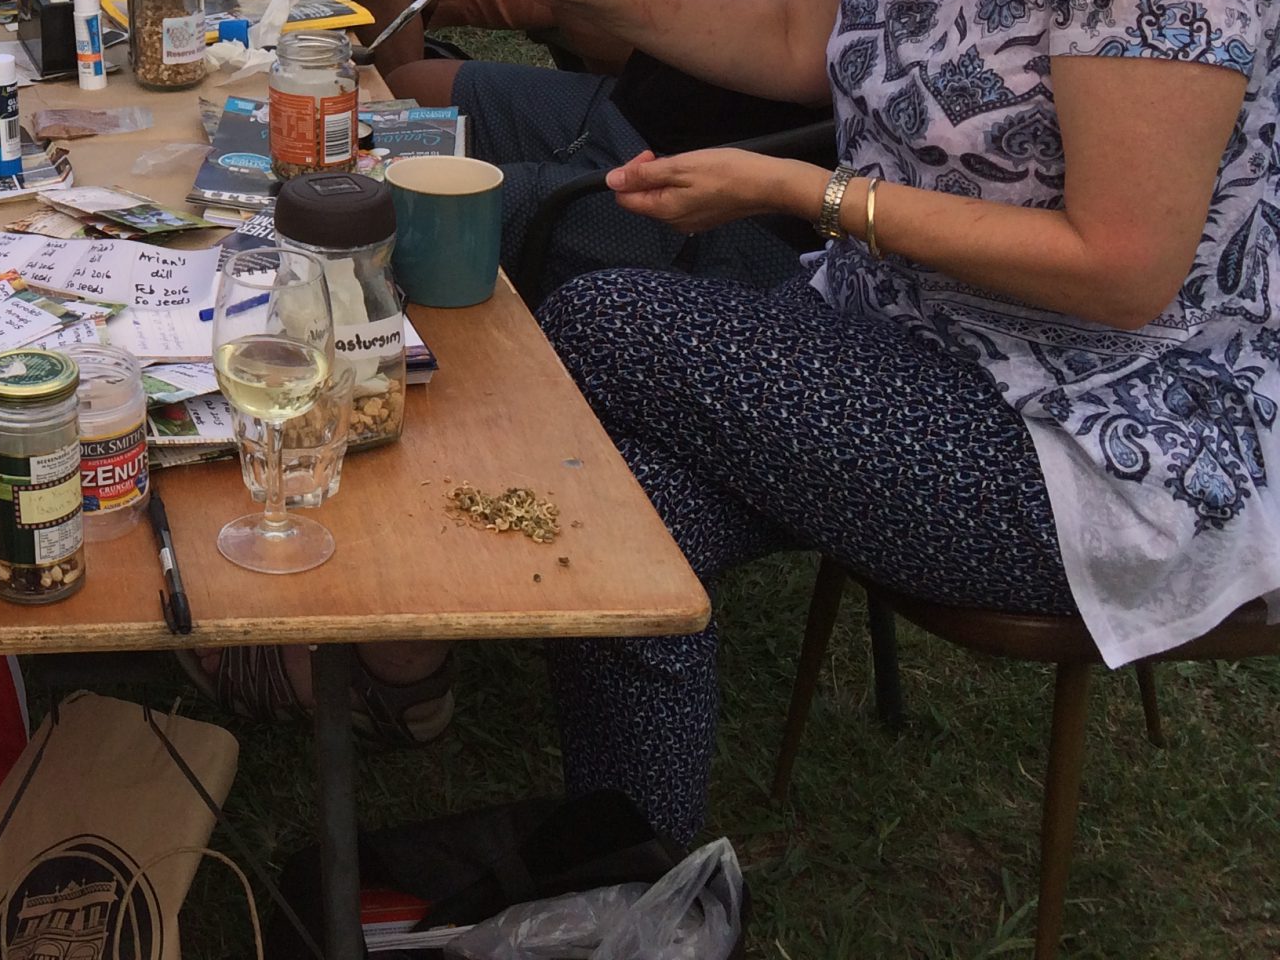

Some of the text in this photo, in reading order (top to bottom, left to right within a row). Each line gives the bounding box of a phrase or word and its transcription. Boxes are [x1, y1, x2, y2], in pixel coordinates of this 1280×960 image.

[138, 251, 186, 267] Arian's
[91, 269, 112, 279] 2016
[150, 269, 173, 280] dill
[77, 282, 104, 295] seeds
[163, 285, 190, 297] 2016
[134, 296, 191, 307] 50 seeds
[80, 444, 105, 456] DICK
